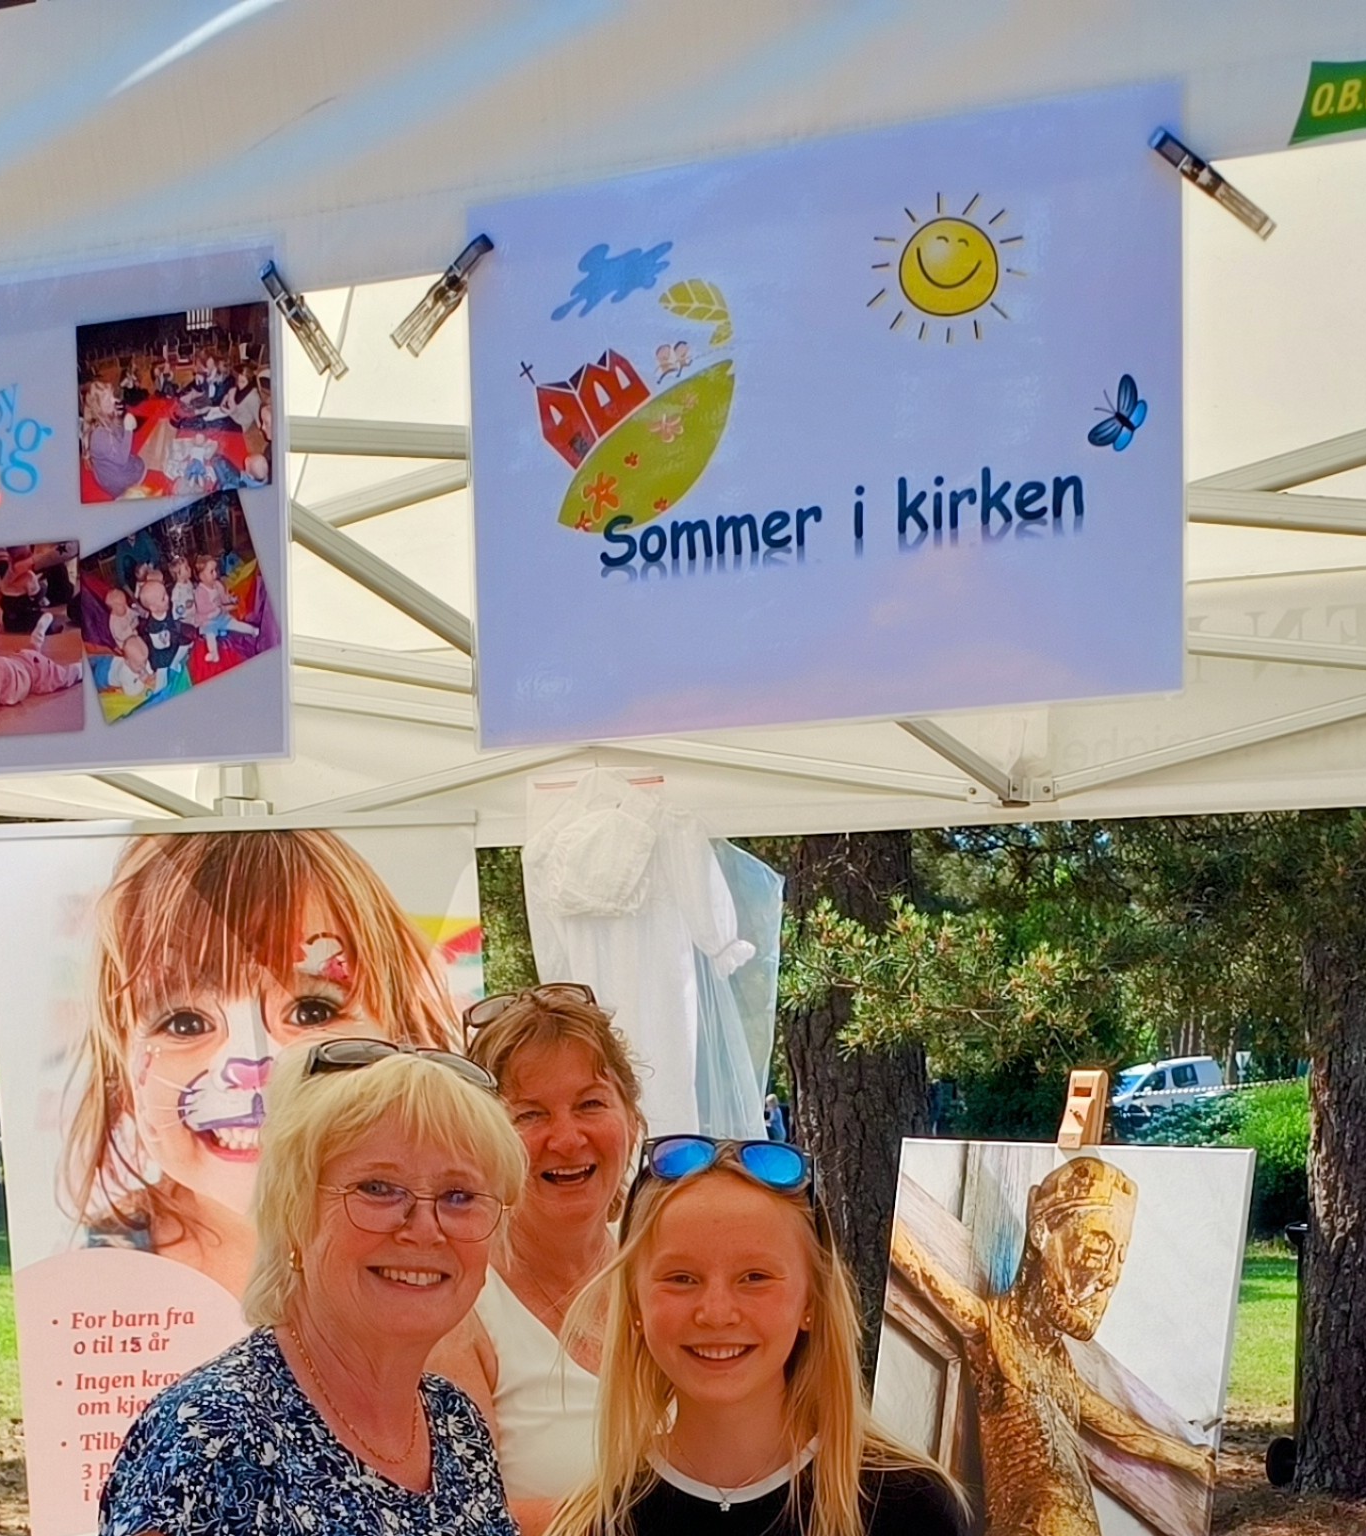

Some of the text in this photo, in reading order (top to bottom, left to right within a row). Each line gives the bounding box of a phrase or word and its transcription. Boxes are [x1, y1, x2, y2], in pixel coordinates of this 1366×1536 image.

[600, 466, 1085, 568] Sommer i kirken
[71, 1307, 195, 1331] For barn fra
[92, 1336, 113, 1354] til
[148, 1332, 171, 1351] år
[75, 1373, 135, 1394] Ingen
[77, 1400, 111, 1416] om
[80, 1433, 124, 1451] Tilb
